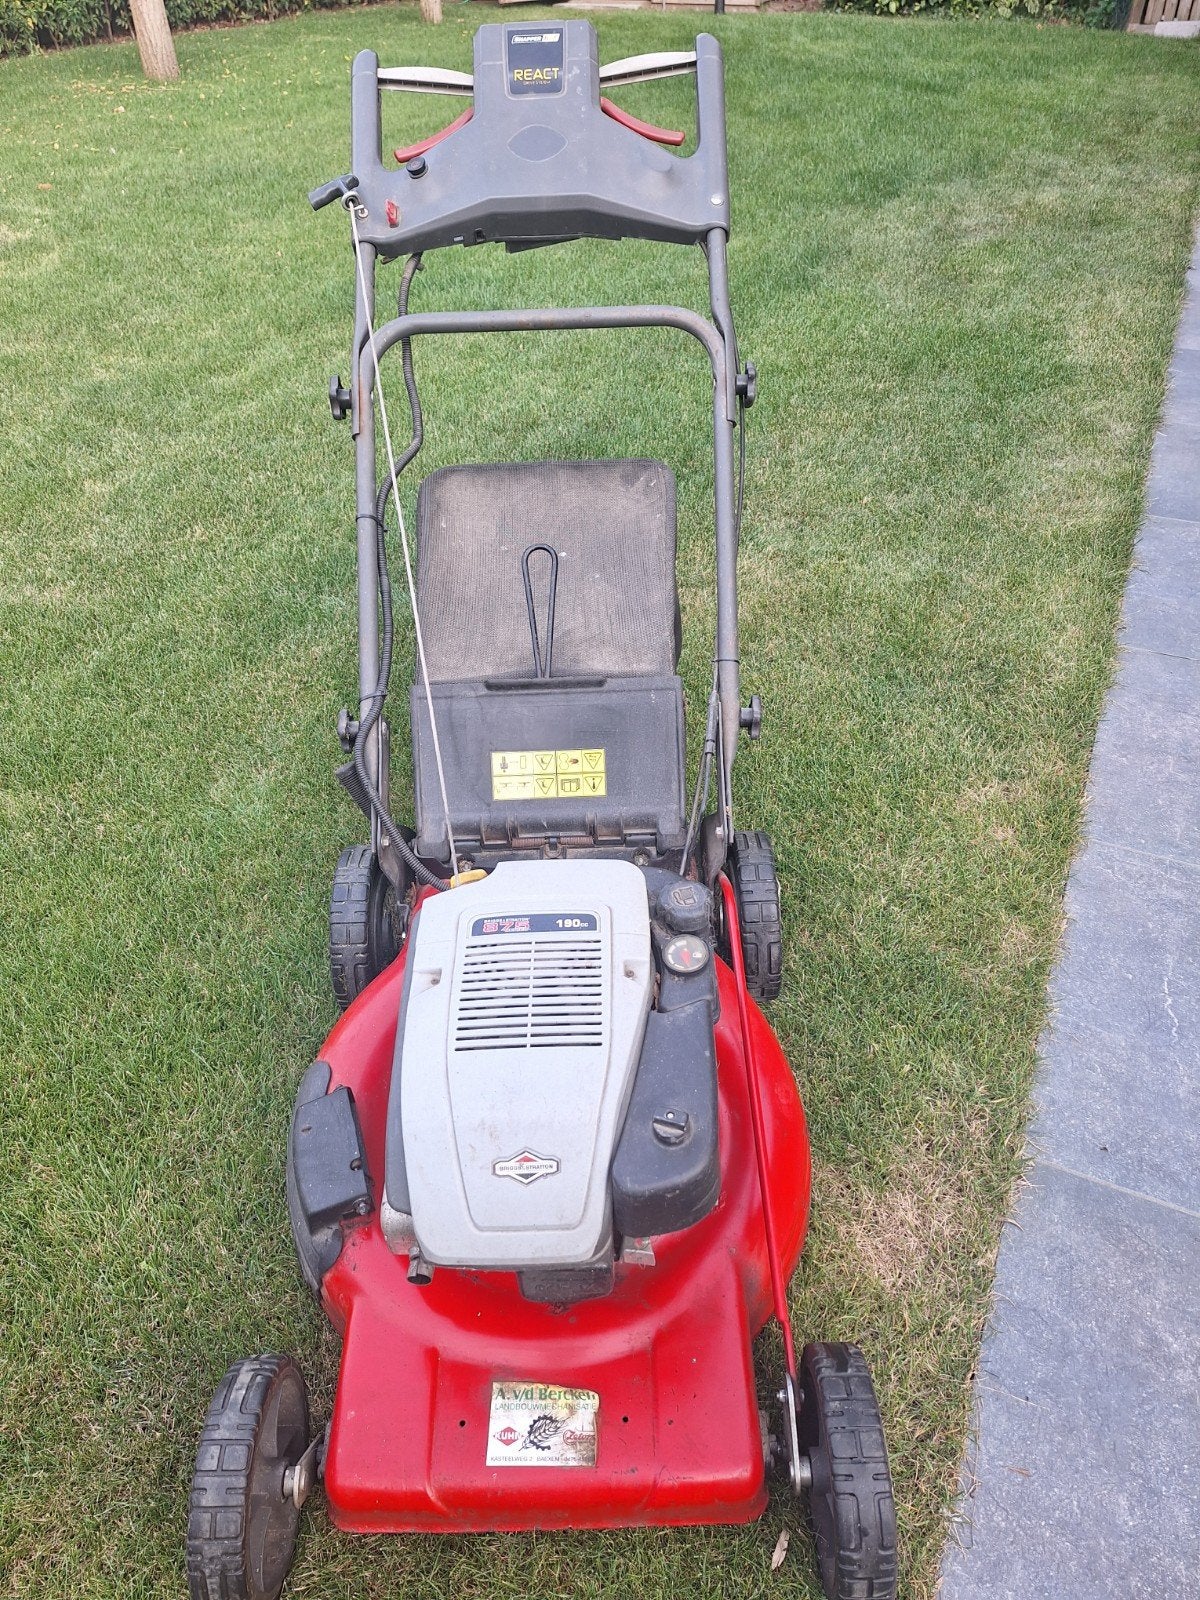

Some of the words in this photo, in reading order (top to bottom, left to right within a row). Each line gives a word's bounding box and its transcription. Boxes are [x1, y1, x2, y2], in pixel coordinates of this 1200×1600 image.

[514, 68, 560, 81] REACT
[482, 921, 530, 933] 875
[555, 919, 589, 928] 190cc
[496, 1387, 511, 1401] A.
[513, 1386, 534, 1402] v/d
[538, 1386, 596, 1401] Bercken
[494, 1402, 596, 1411] LANDBOUWMECHANISATIE
[494, 1431, 522, 1441] KUHN
